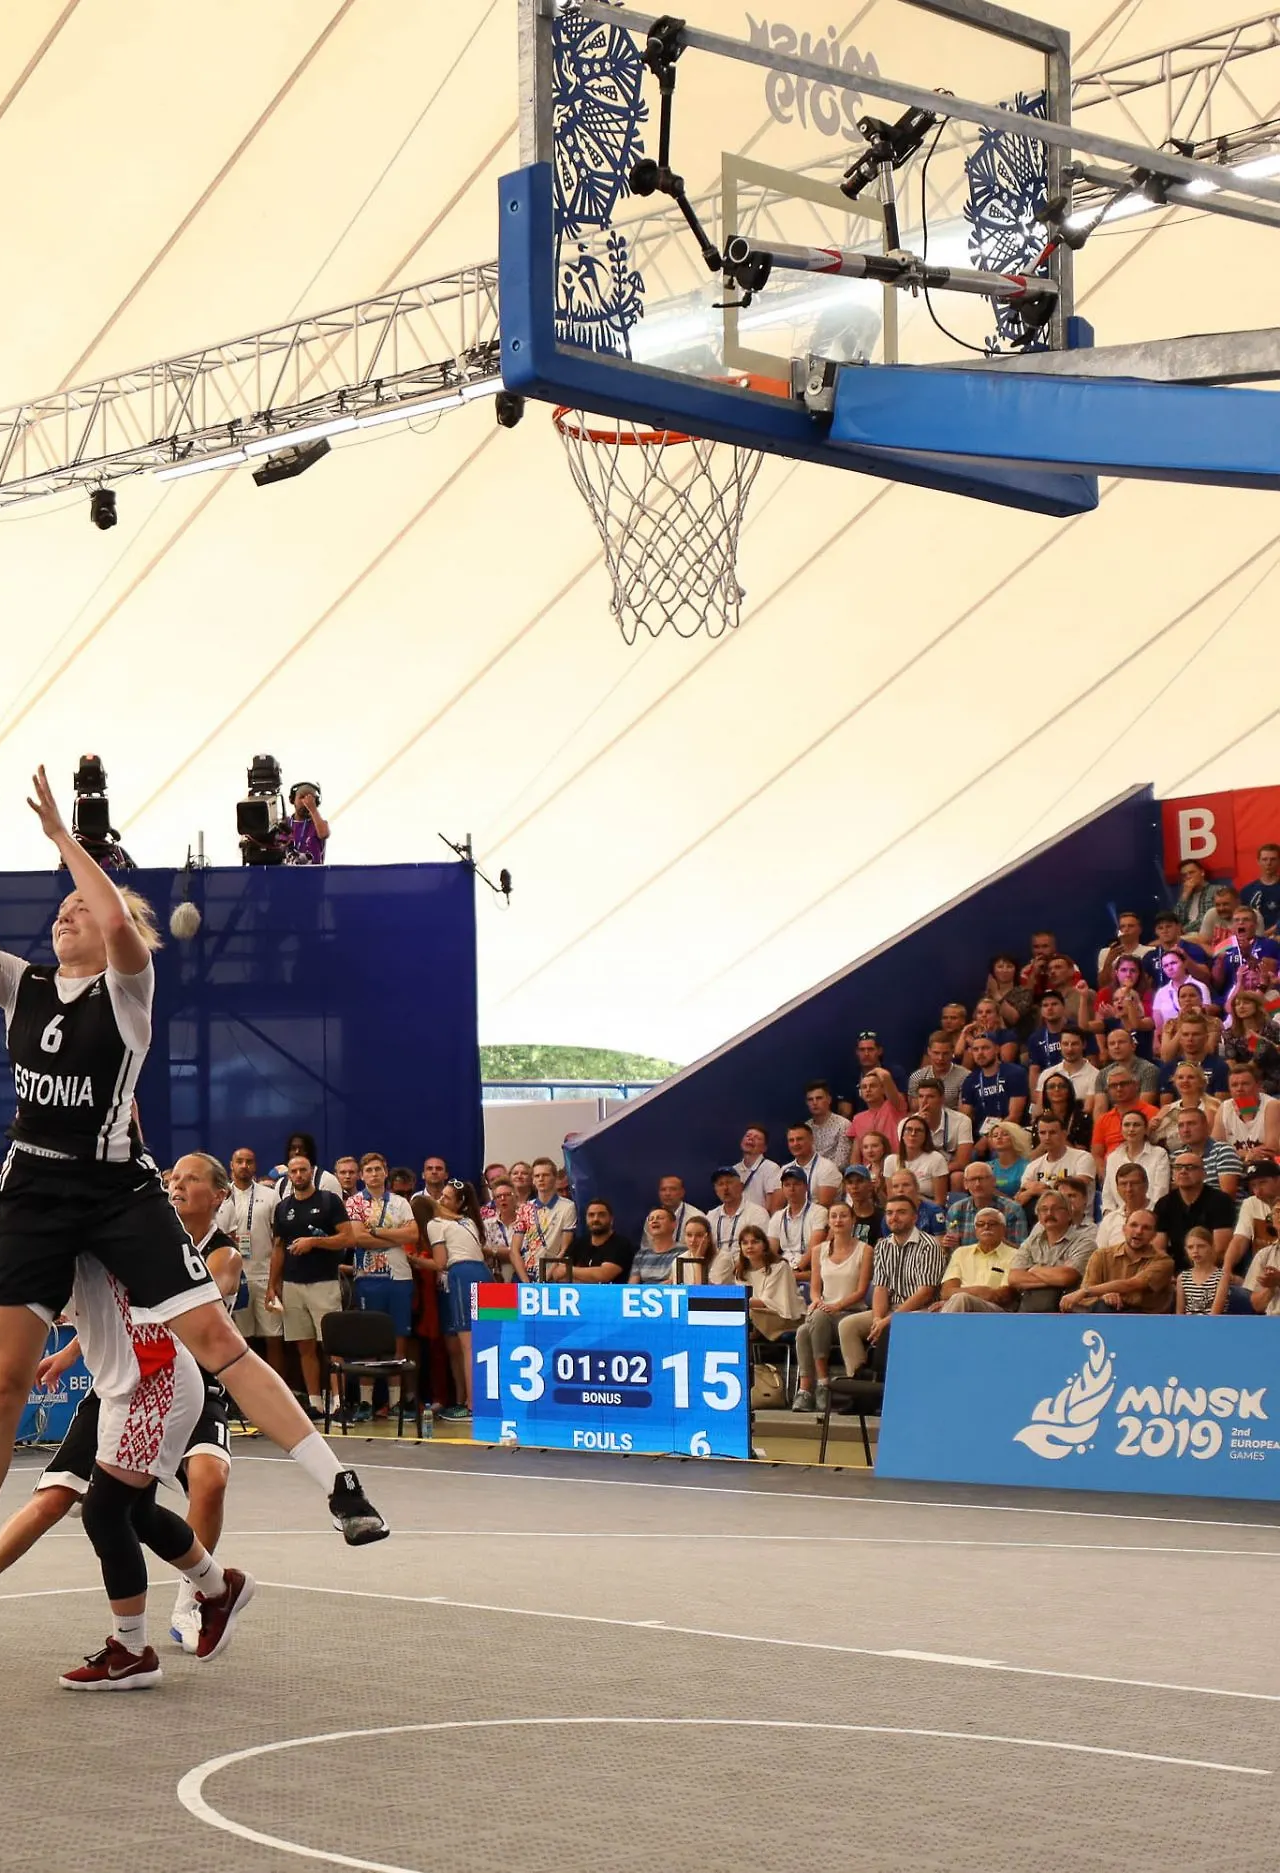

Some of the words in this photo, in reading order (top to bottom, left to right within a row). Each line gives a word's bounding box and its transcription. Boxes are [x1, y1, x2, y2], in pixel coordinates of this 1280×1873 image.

[1178, 807, 1218, 861] B
[40, 1014, 65, 1054] 6
[14, 1062, 95, 1107] ESTONIA
[182, 1243, 207, 1281] 6
[520, 1286, 581, 1317] BLR
[622, 1287, 687, 1319] EST
[476, 1345, 546, 1403] 13
[557, 1353, 649, 1383] 01:02
[661, 1350, 742, 1411] 15
[581, 1391, 622, 1405] BONUS
[500, 1420, 518, 1441] 5
[572, 1429, 634, 1451] FOULS
[689, 1430, 712, 1457] 6
[1115, 1416, 1223, 1460] 2019
[1231, 1427, 1251, 1437] 2nd
[1229, 1450, 1265, 1461] GAMES
